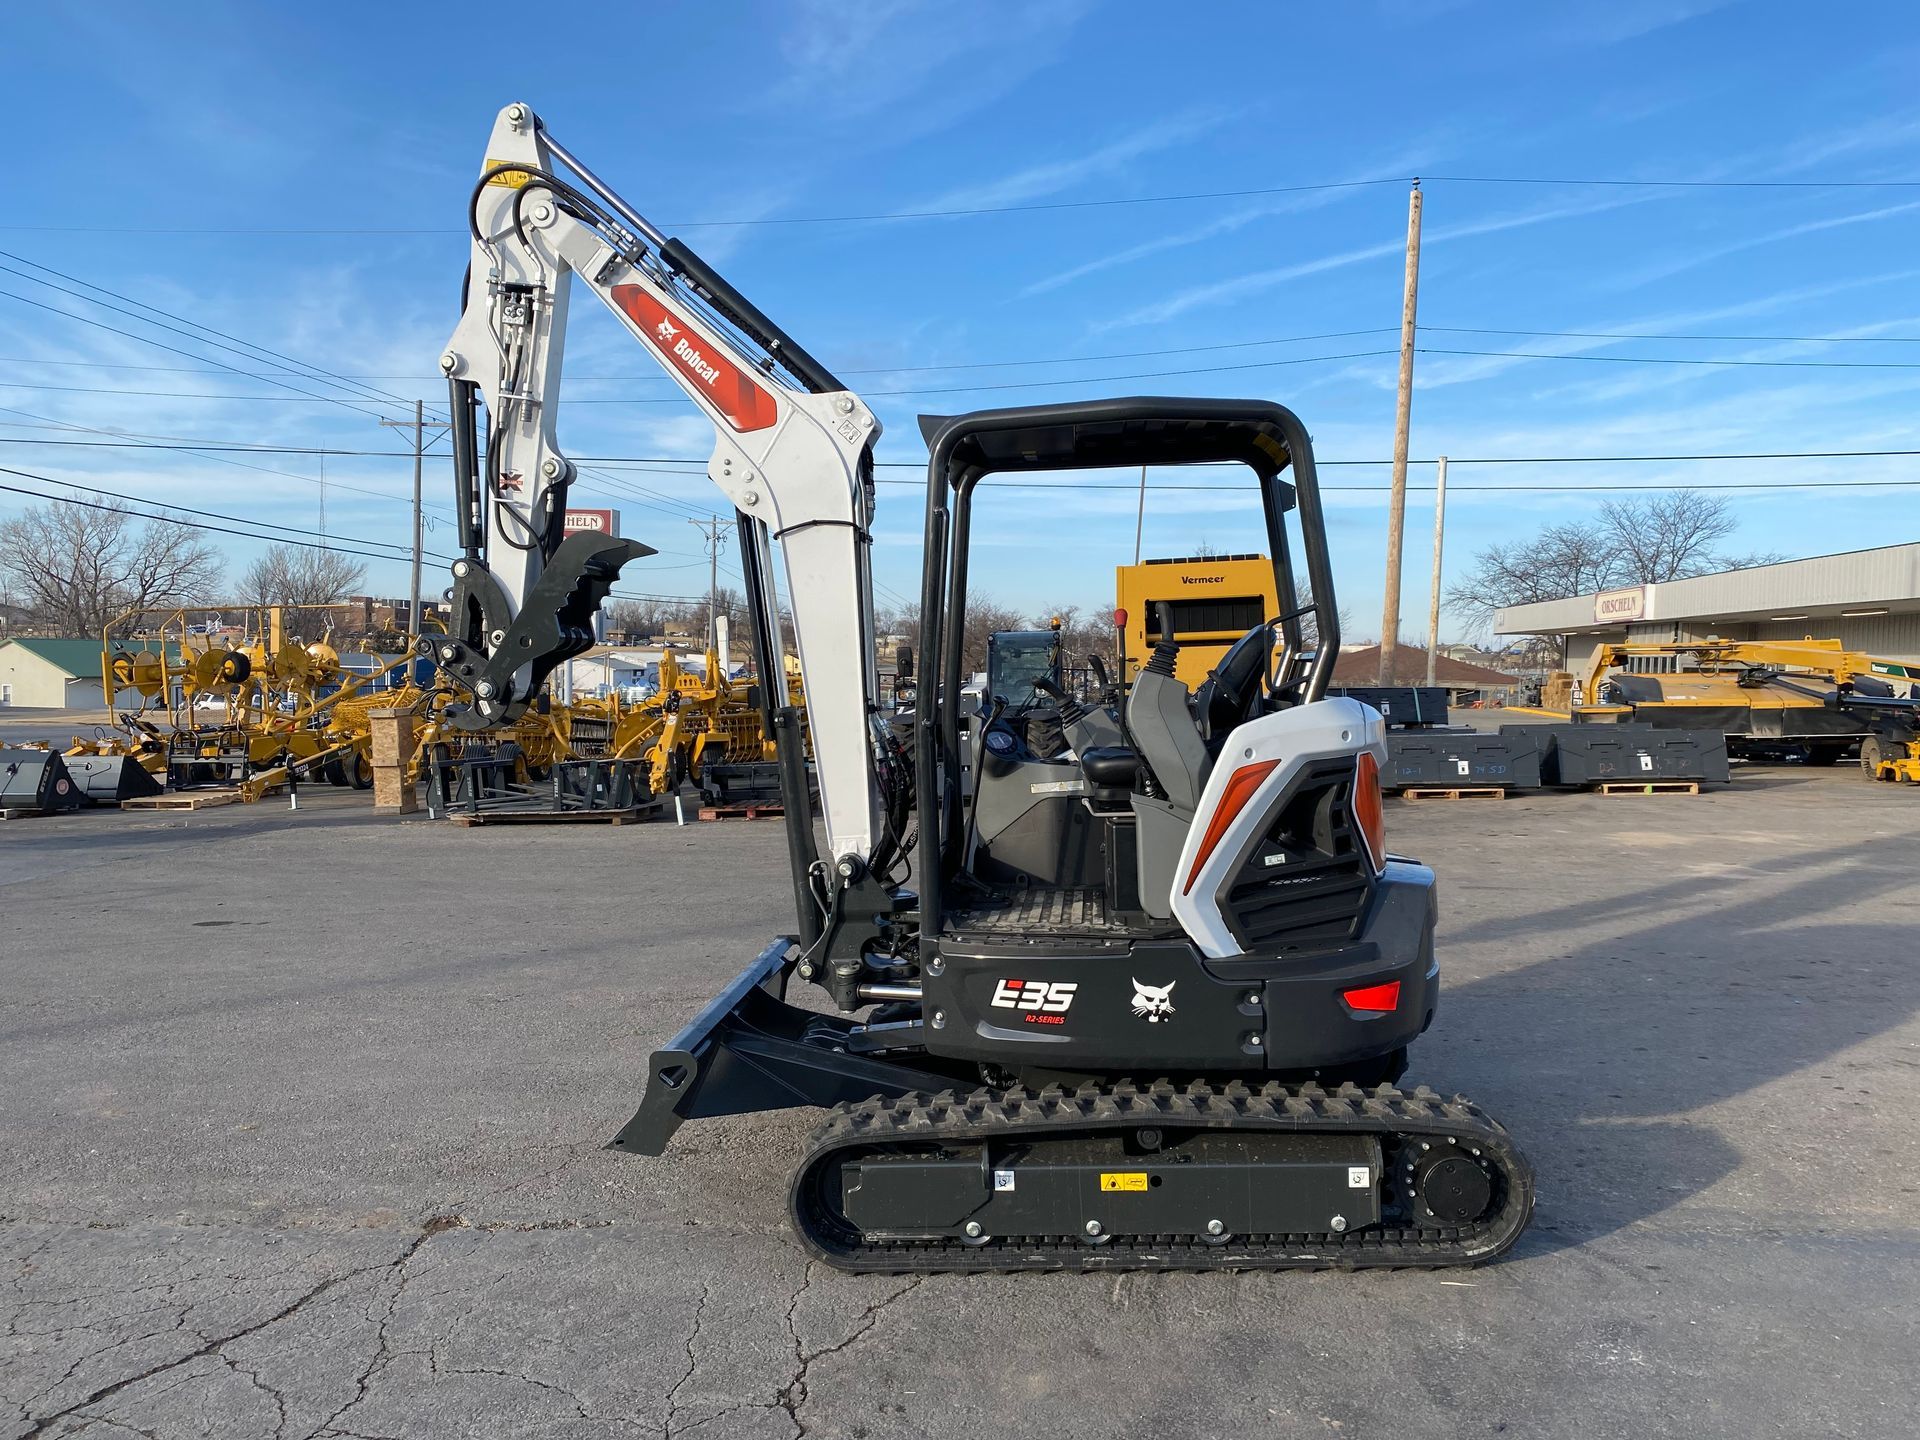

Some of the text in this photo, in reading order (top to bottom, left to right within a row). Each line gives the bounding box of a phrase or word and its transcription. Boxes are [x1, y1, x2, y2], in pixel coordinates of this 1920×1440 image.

[673, 337, 720, 385] Bobcat
[564, 516, 598, 530] HELN
[1181, 575, 1225, 585] Vermeer
[1601, 596, 1636, 616] ORSCHELN
[991, 979, 1078, 1012] E35
[1025, 1014, 1066, 1025] R2-SERIES
